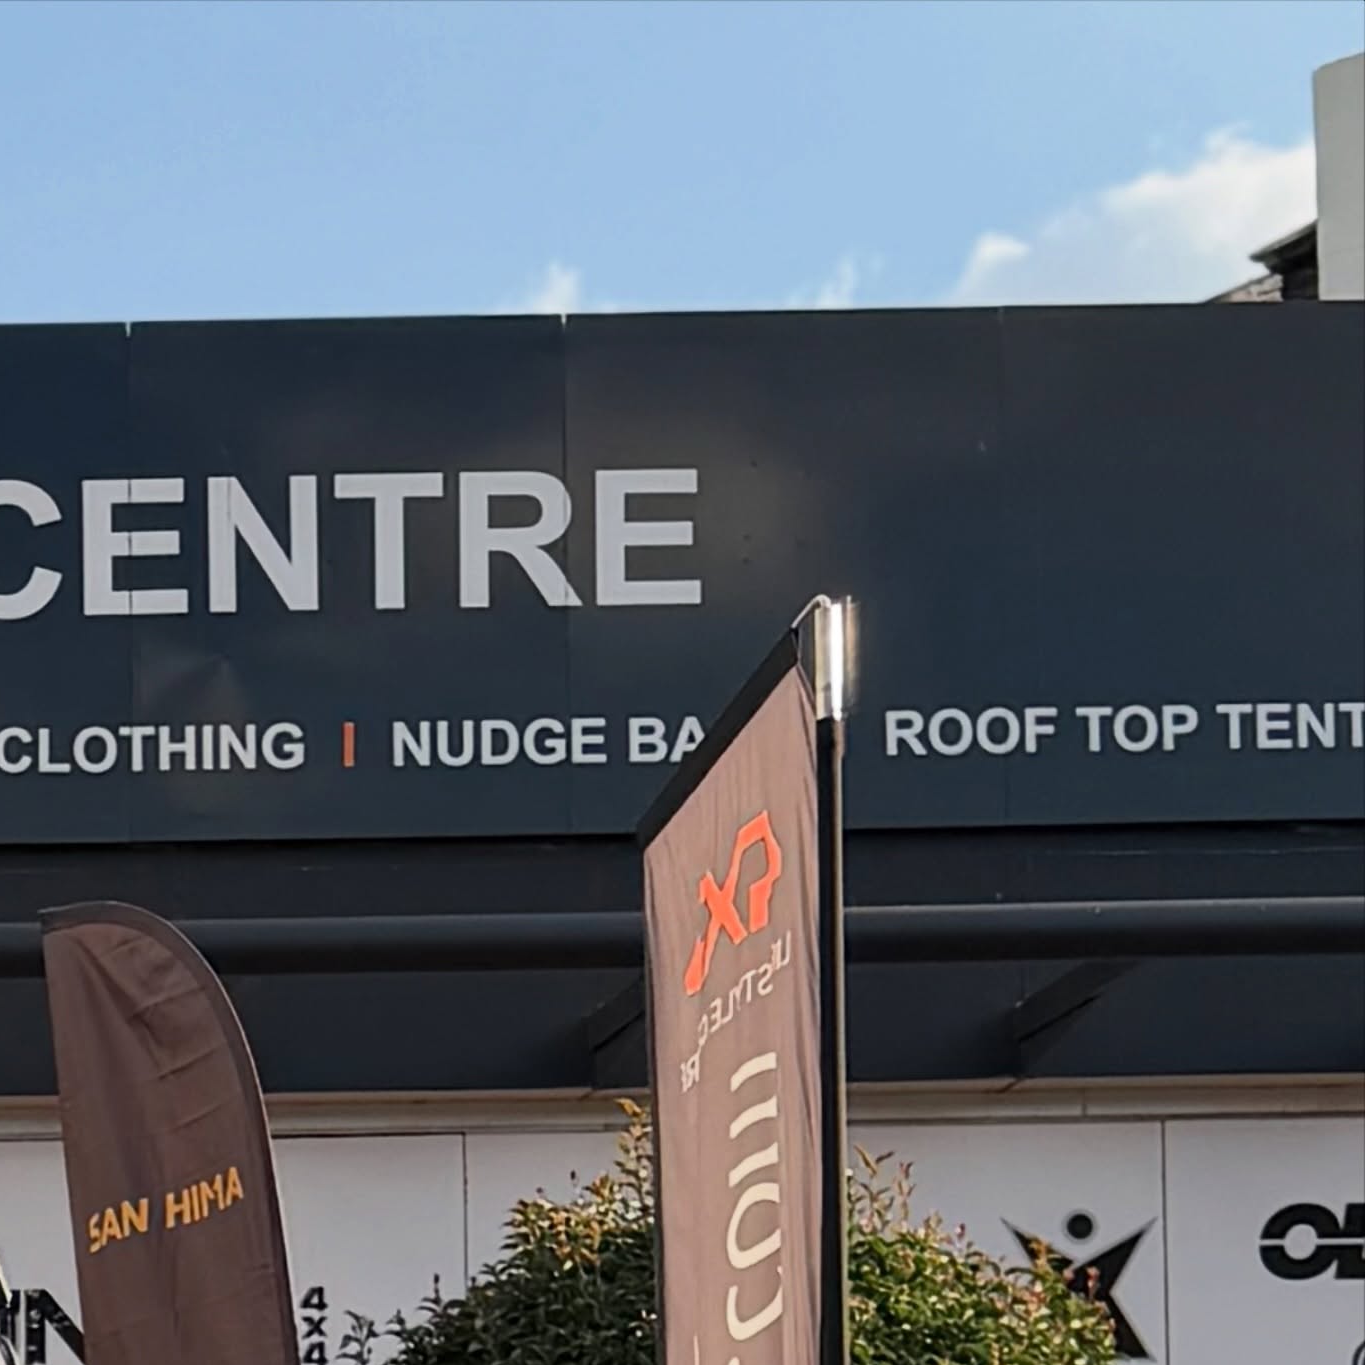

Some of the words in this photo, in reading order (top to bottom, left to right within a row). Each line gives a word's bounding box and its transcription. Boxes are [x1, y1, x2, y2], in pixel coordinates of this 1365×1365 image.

[392, 717, 607, 768] NUDGE
[885, 707, 1058, 757] ROOF
[1075, 705, 1199, 753] TOP
[87, 1198, 149, 1254] SAN
[164, 1165, 245, 1229] HIMA
